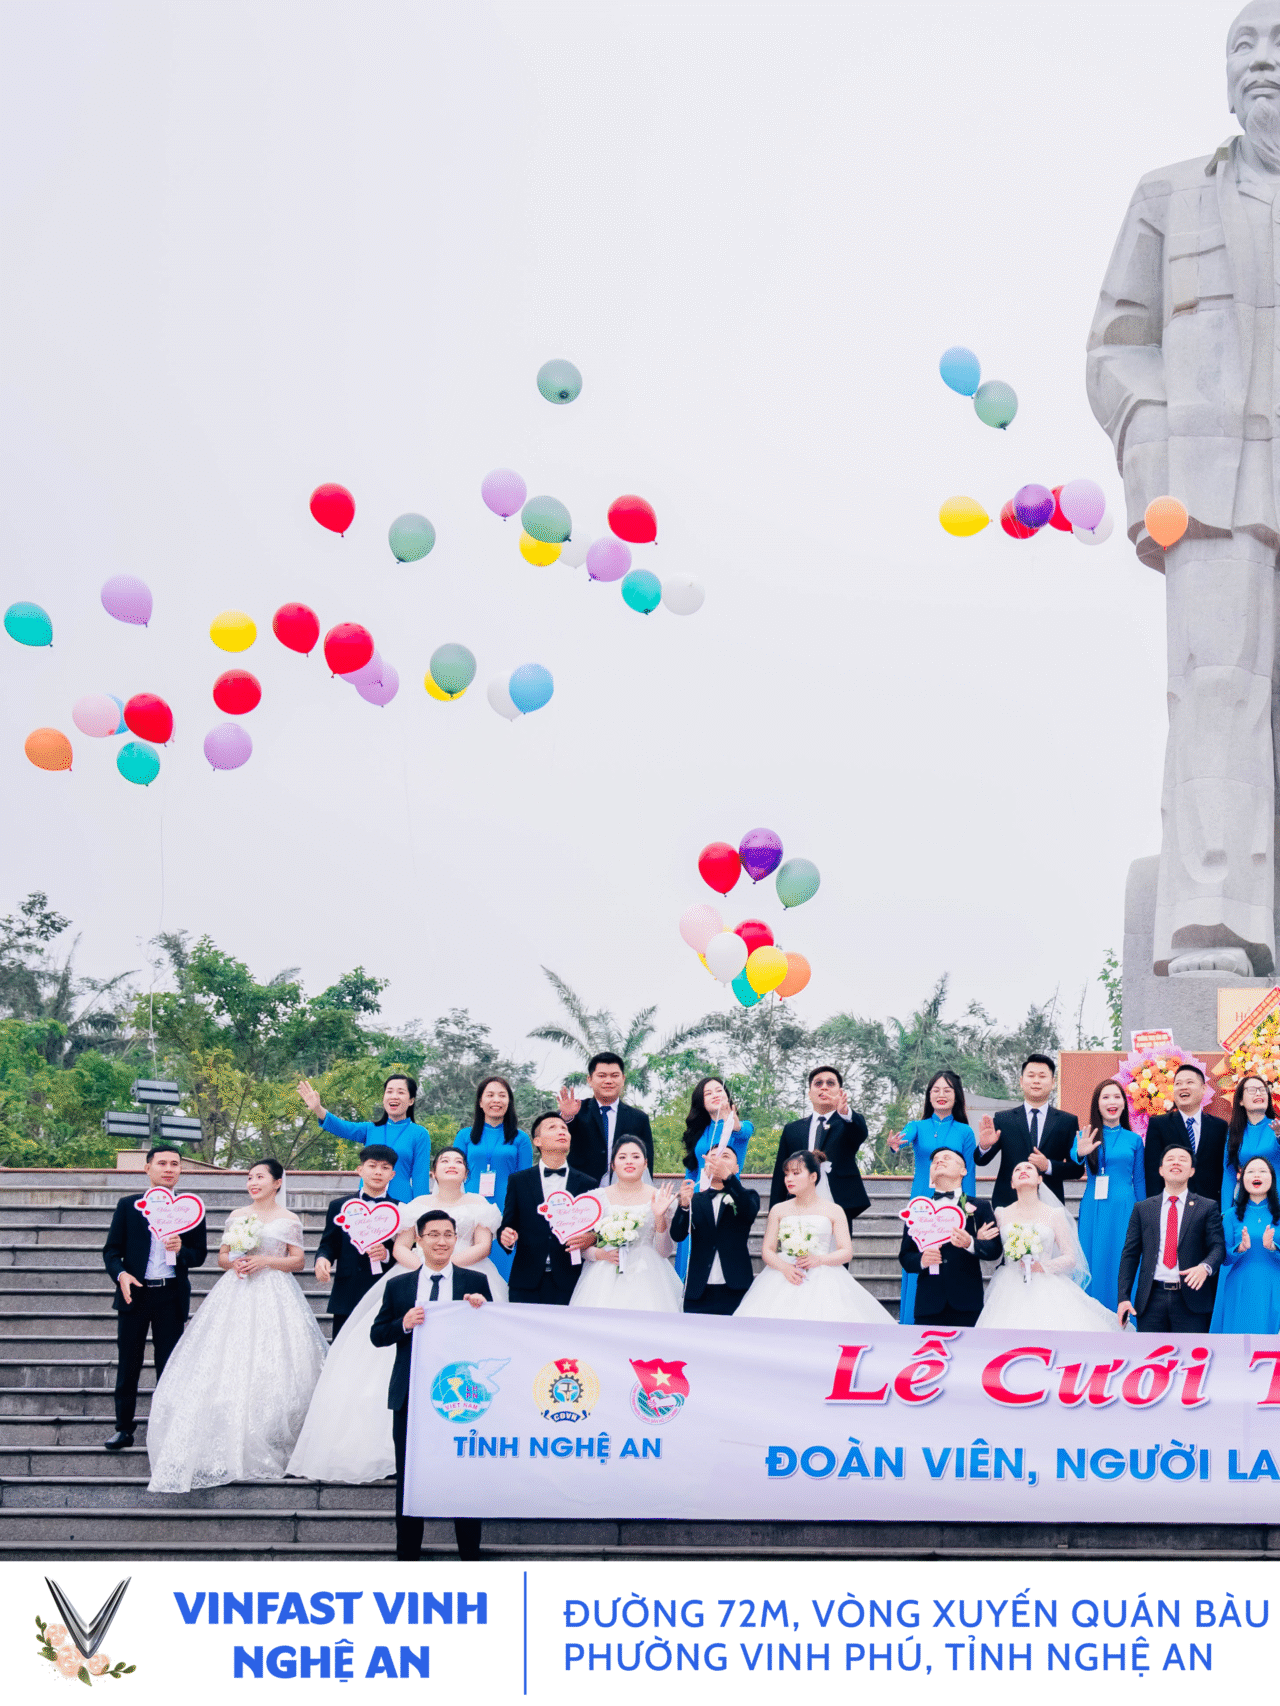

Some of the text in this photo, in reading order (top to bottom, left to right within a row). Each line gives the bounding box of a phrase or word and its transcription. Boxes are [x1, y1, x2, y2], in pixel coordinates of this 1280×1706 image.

[825, 1330, 958, 1403] Lễ
[981, 1344, 1210, 1406] Cưới
[453, 1428, 662, 1464] TỈNH NGHỆ AN
[764, 1437, 904, 1478] ĐOÀN
[921, 1438, 1037, 1486] VIÊN,
[1056, 1439, 1209, 1481] NGƯỜI
